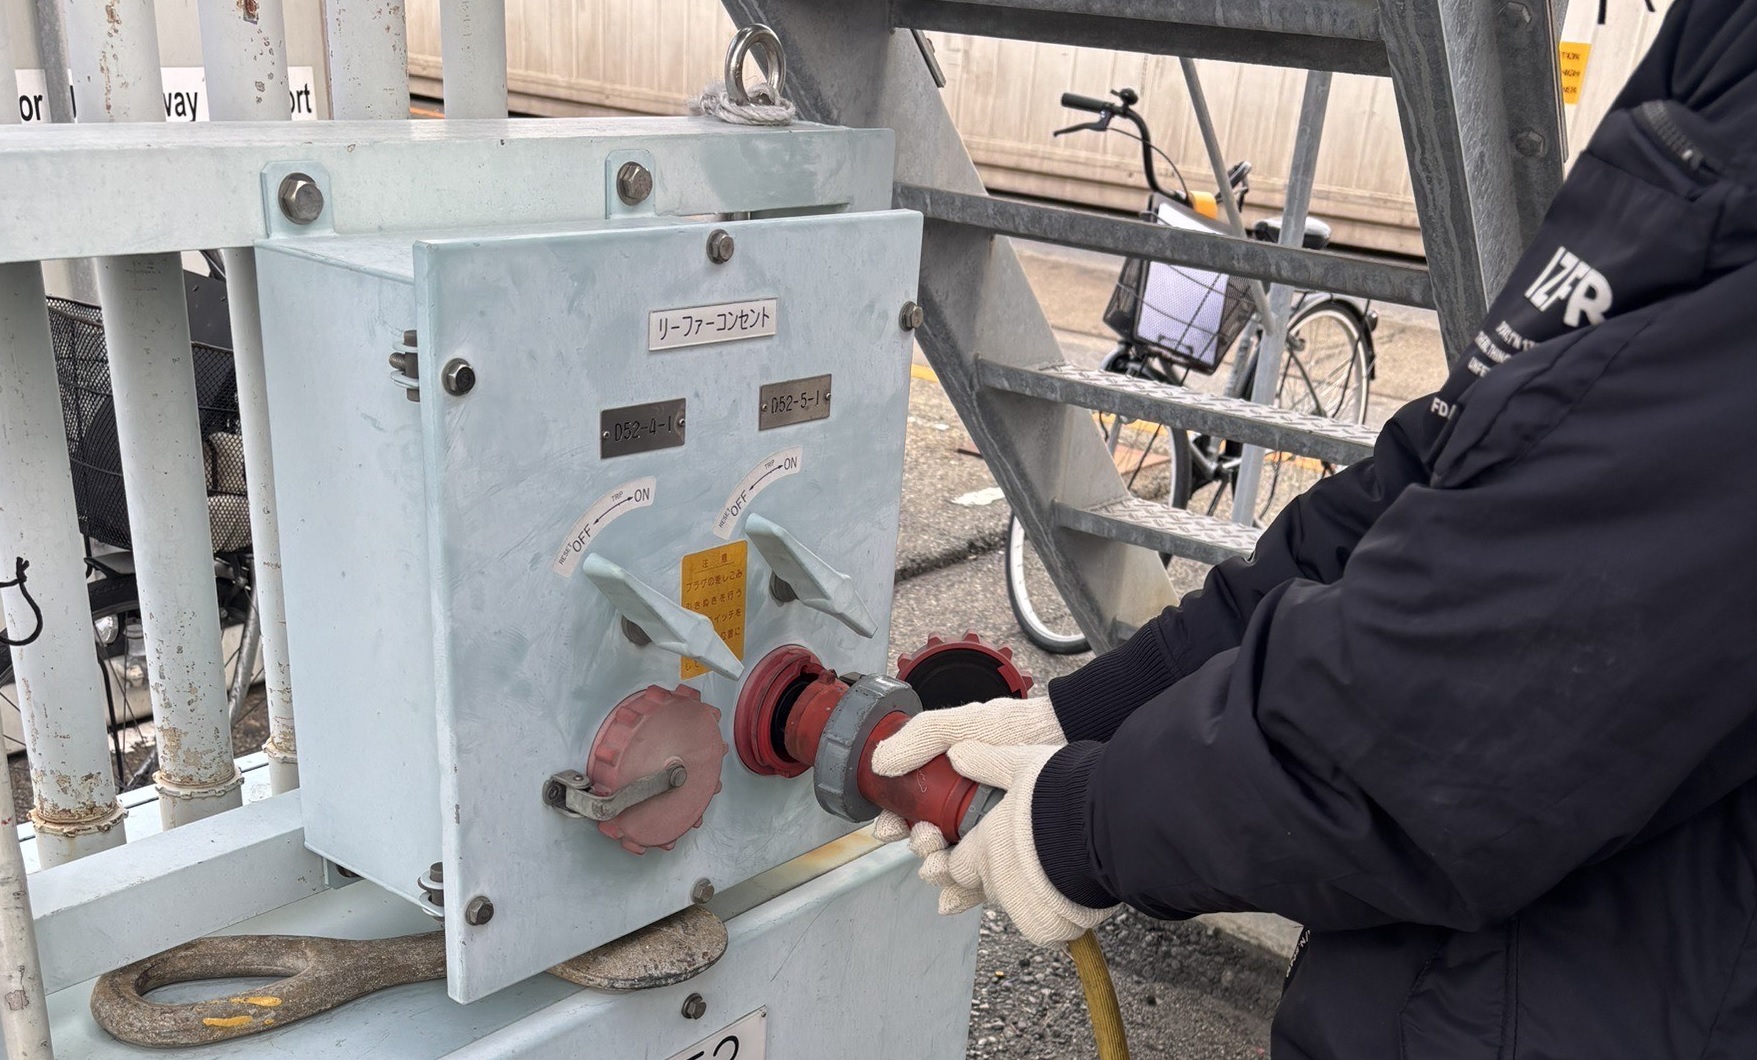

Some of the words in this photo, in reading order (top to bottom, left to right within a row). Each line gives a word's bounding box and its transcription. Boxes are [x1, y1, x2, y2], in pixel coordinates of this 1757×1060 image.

[659, 306, 770, 340] リーファーコンセント
[771, 390, 820, 414] D52-5-1
[614, 415, 672, 442] D52-4-1
[719, 508, 731, 528] RESET
[730, 490, 747, 517] OFF
[783, 457, 797, 470] ON
[558, 543, 573, 566] RESET
[572, 523, 591, 553] OFF
[611, 490, 624, 502] TRIP
[634, 487, 650, 502] ON
